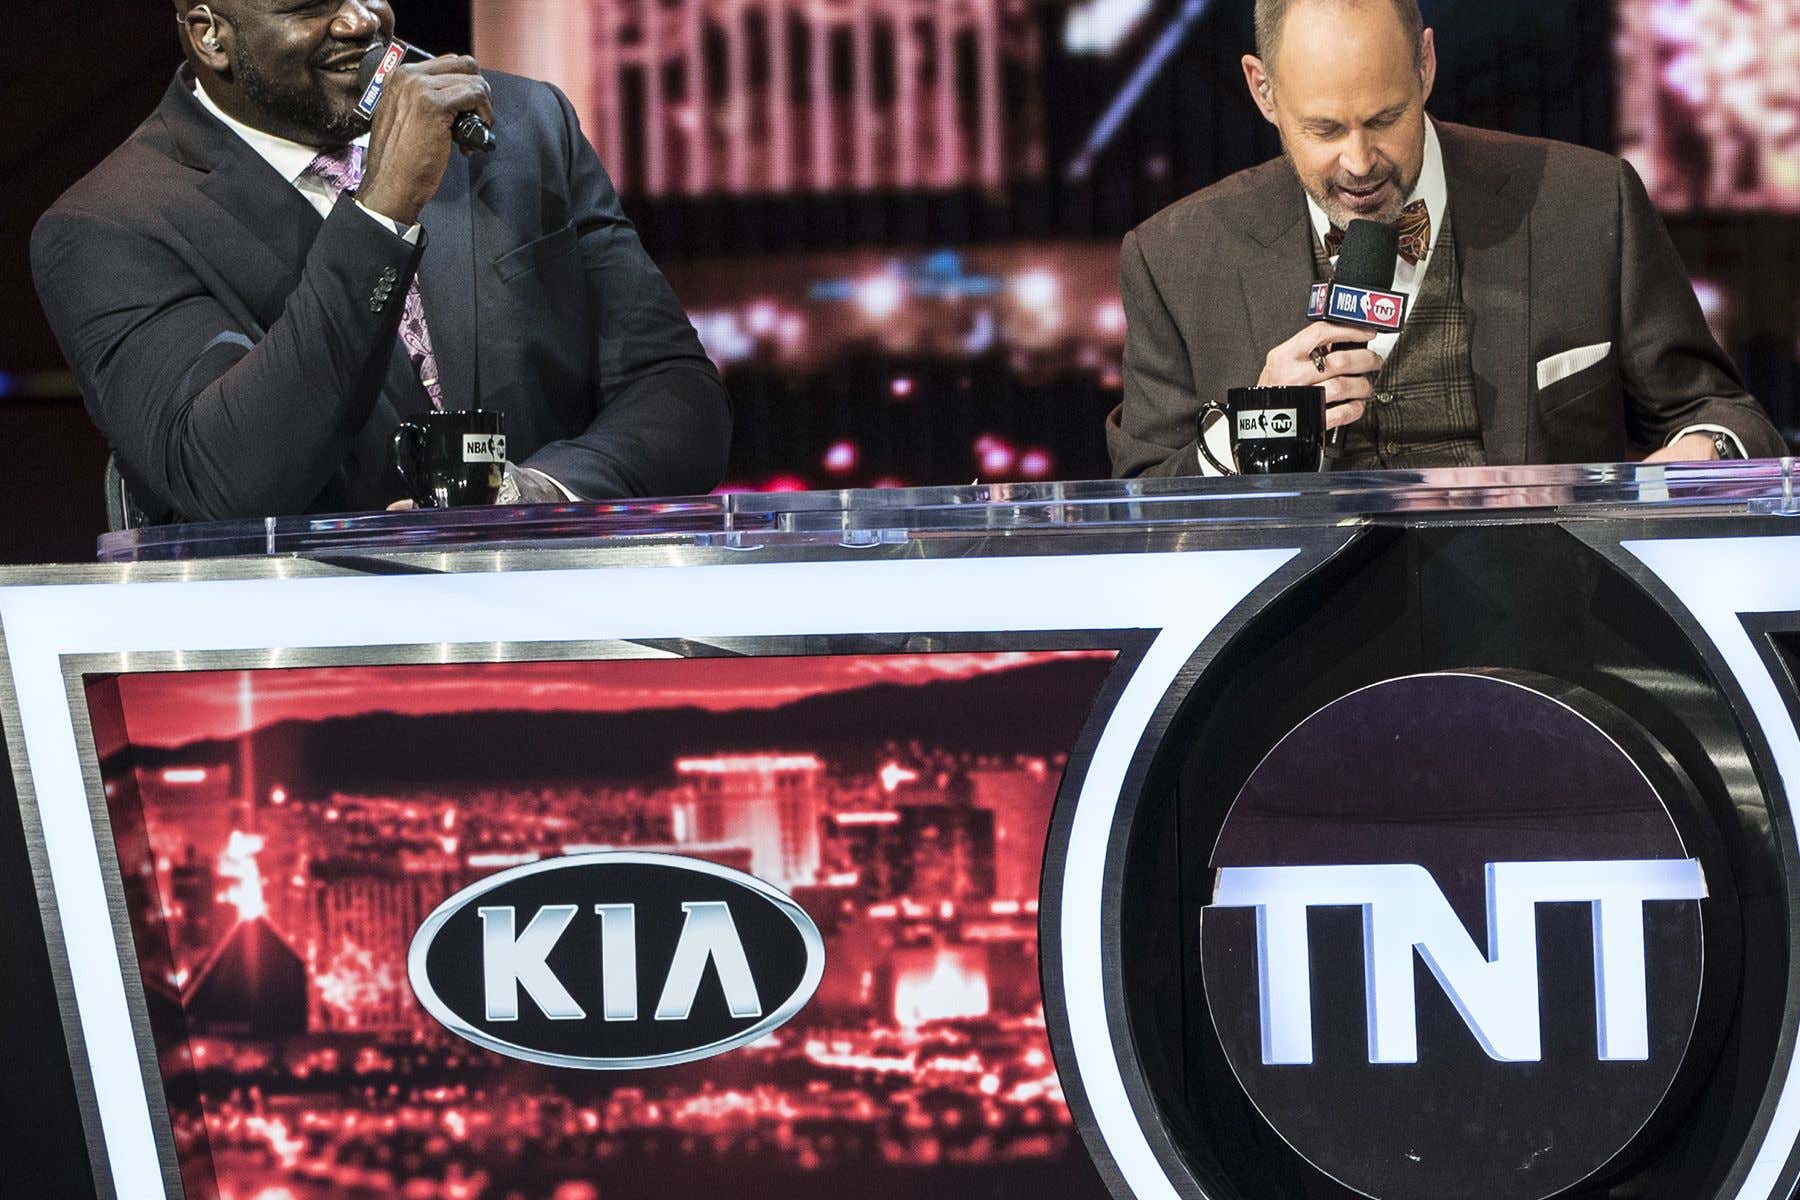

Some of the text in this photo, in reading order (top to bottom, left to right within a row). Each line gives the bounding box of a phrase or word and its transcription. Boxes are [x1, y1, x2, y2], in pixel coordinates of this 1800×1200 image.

[364, 85, 380, 106] NBA
[1336, 292, 1358, 313] NBA
[1374, 303, 1395, 318] TNT
[1240, 418, 1292, 431] NBA TNT
[467, 441, 488, 454] NBA
[477, 901, 763, 1022] KIA
[1212, 857, 1710, 1065] TNT
